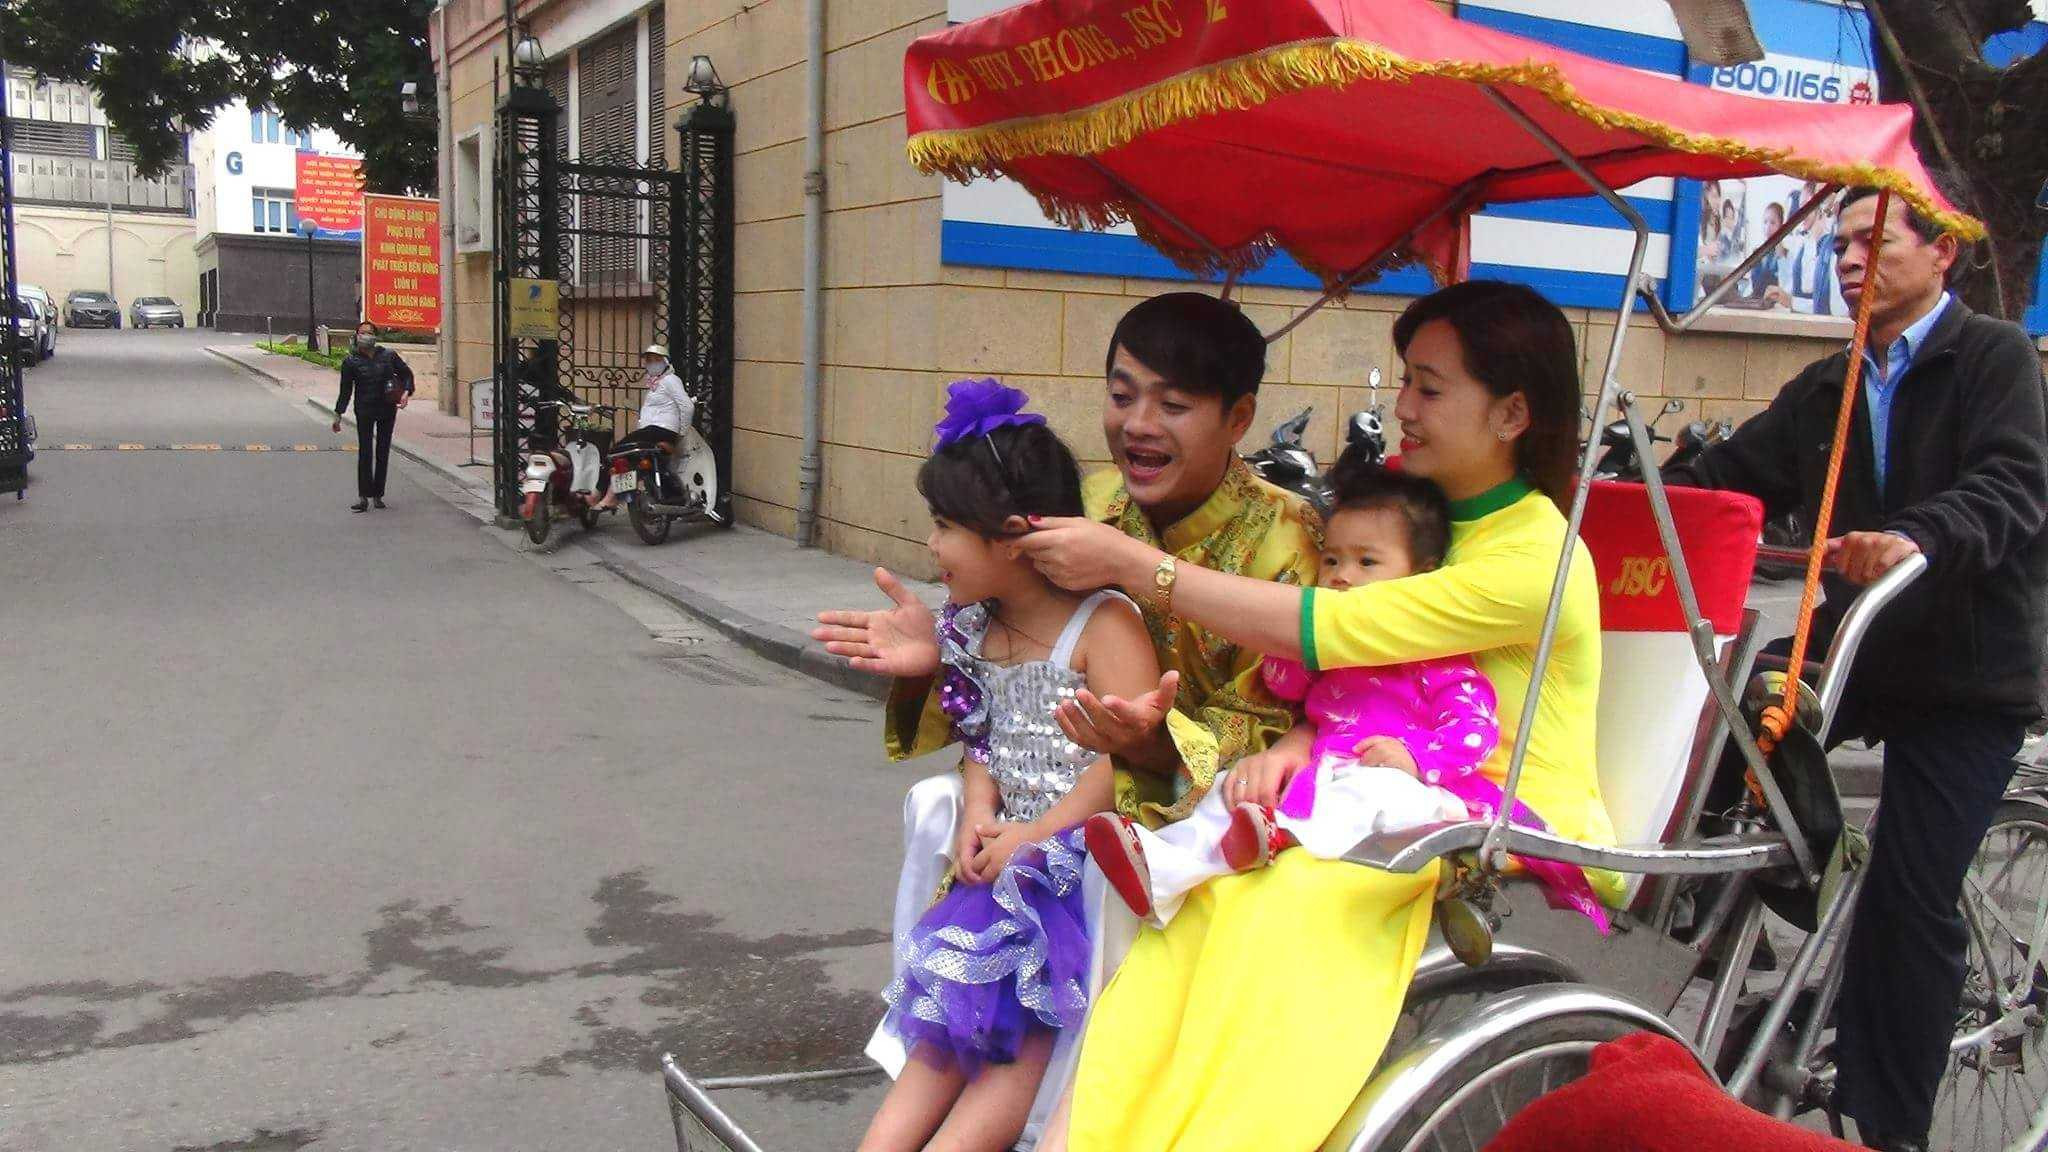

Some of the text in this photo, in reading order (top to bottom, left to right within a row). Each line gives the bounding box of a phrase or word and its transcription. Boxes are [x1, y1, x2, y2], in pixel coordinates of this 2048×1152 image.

[967, 51, 1023, 89] HUY
[1121, 0, 1182, 49] JSC
[226, 151, 243, 175] G
[1611, 556, 1666, 597] JSC
